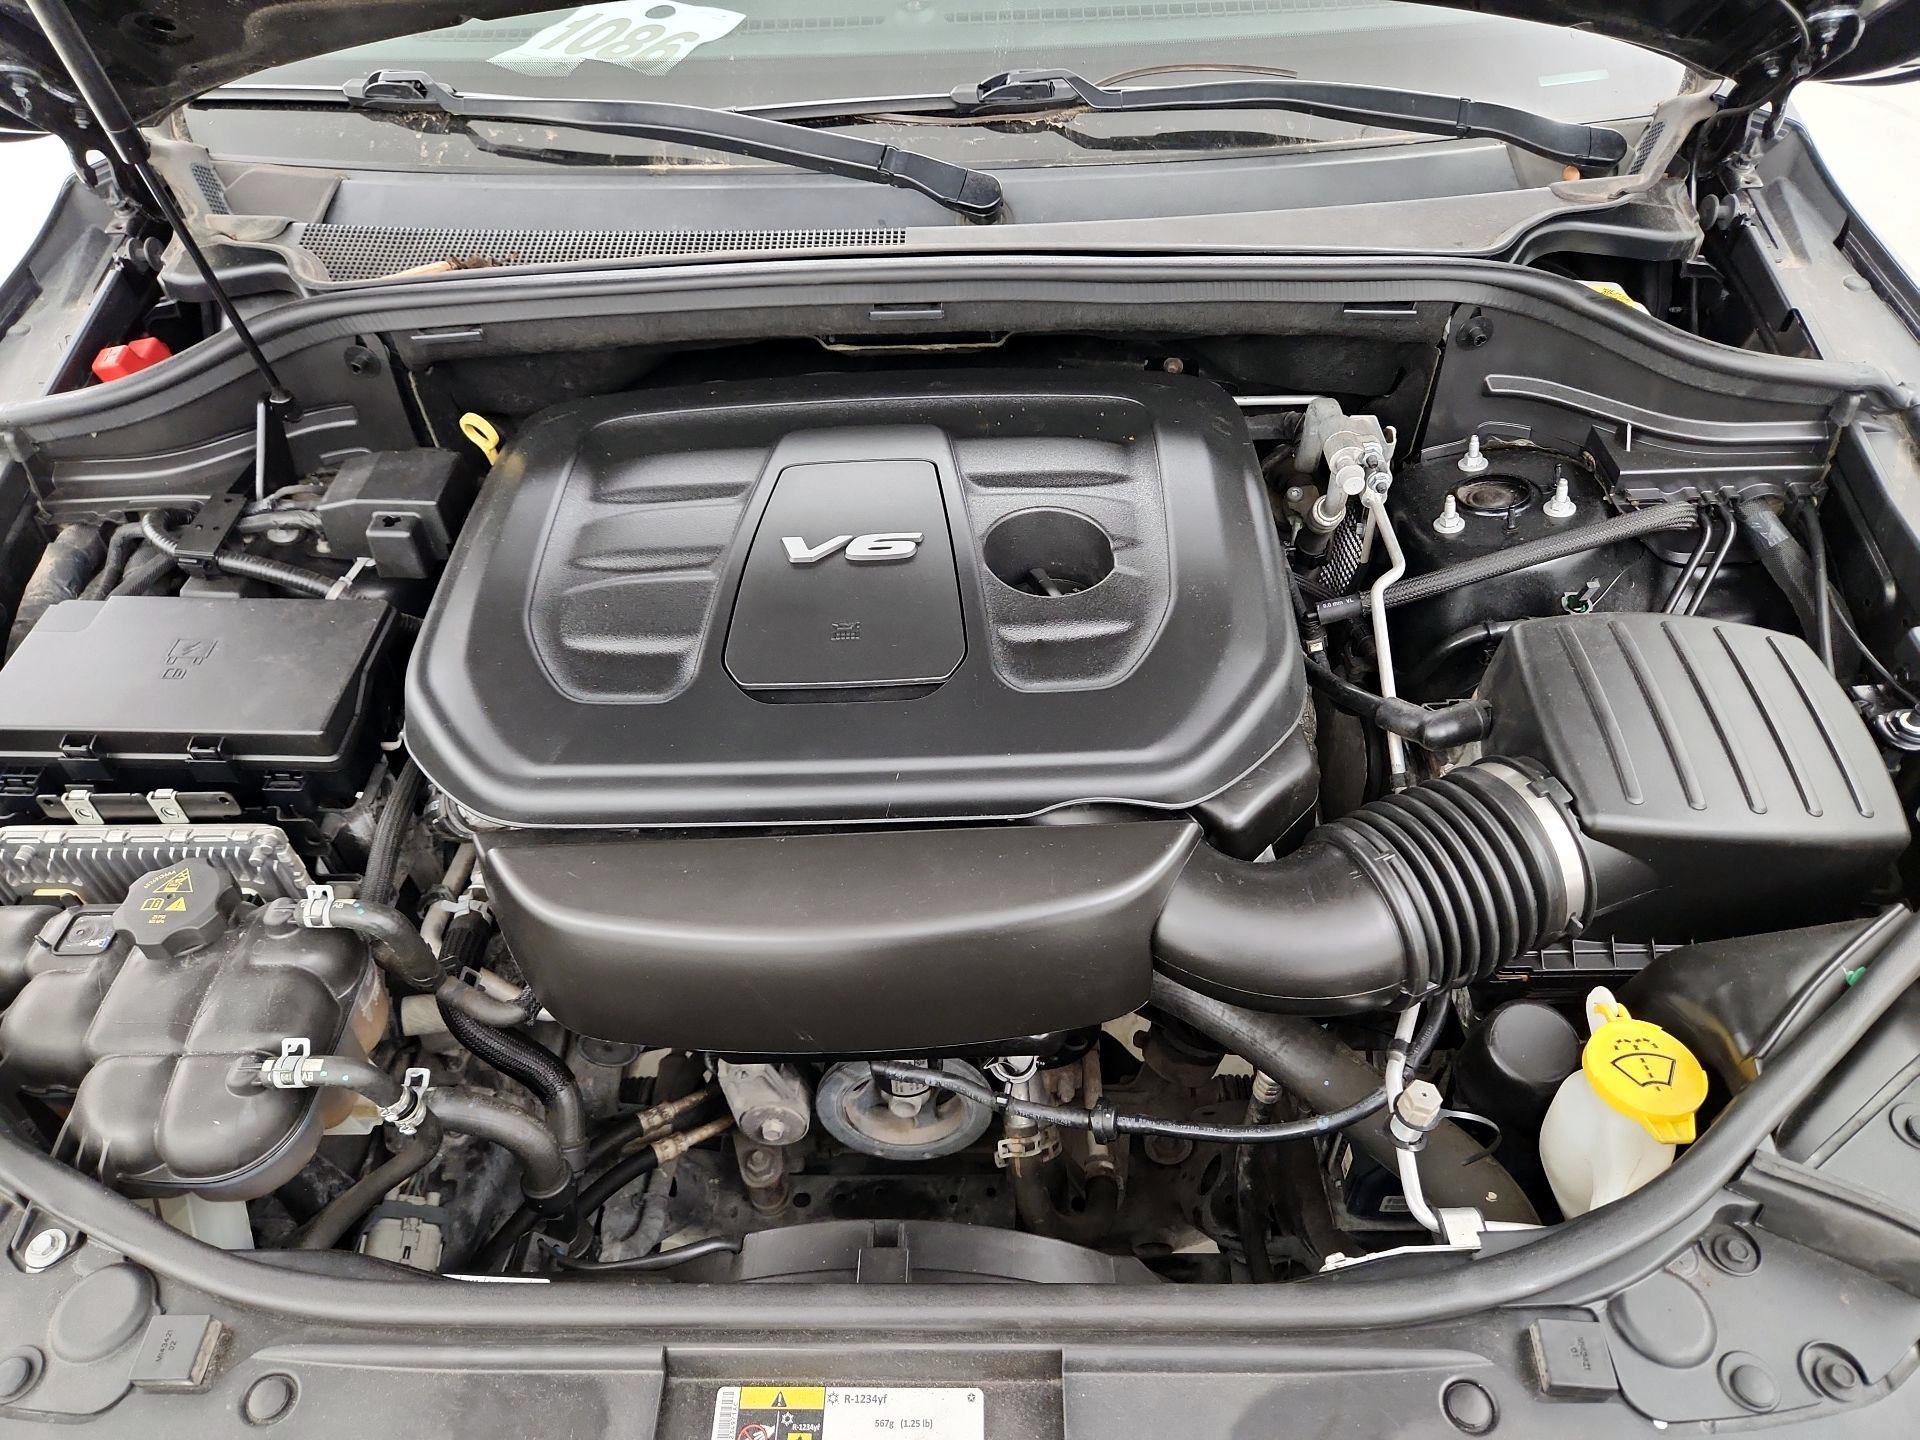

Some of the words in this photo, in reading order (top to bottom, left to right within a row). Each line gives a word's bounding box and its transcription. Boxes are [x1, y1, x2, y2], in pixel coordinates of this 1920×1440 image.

[539, 12, 700, 67] 1086
[781, 532, 925, 564] V6
[844, 1394, 888, 1406] R-1234yf
[792, 1423, 821, 1432] R-1234yf
[874, 1419, 895, 1429] 567g
[900, 1418, 921, 1429] (1.25
[922, 1418, 933, 1429] lb)
